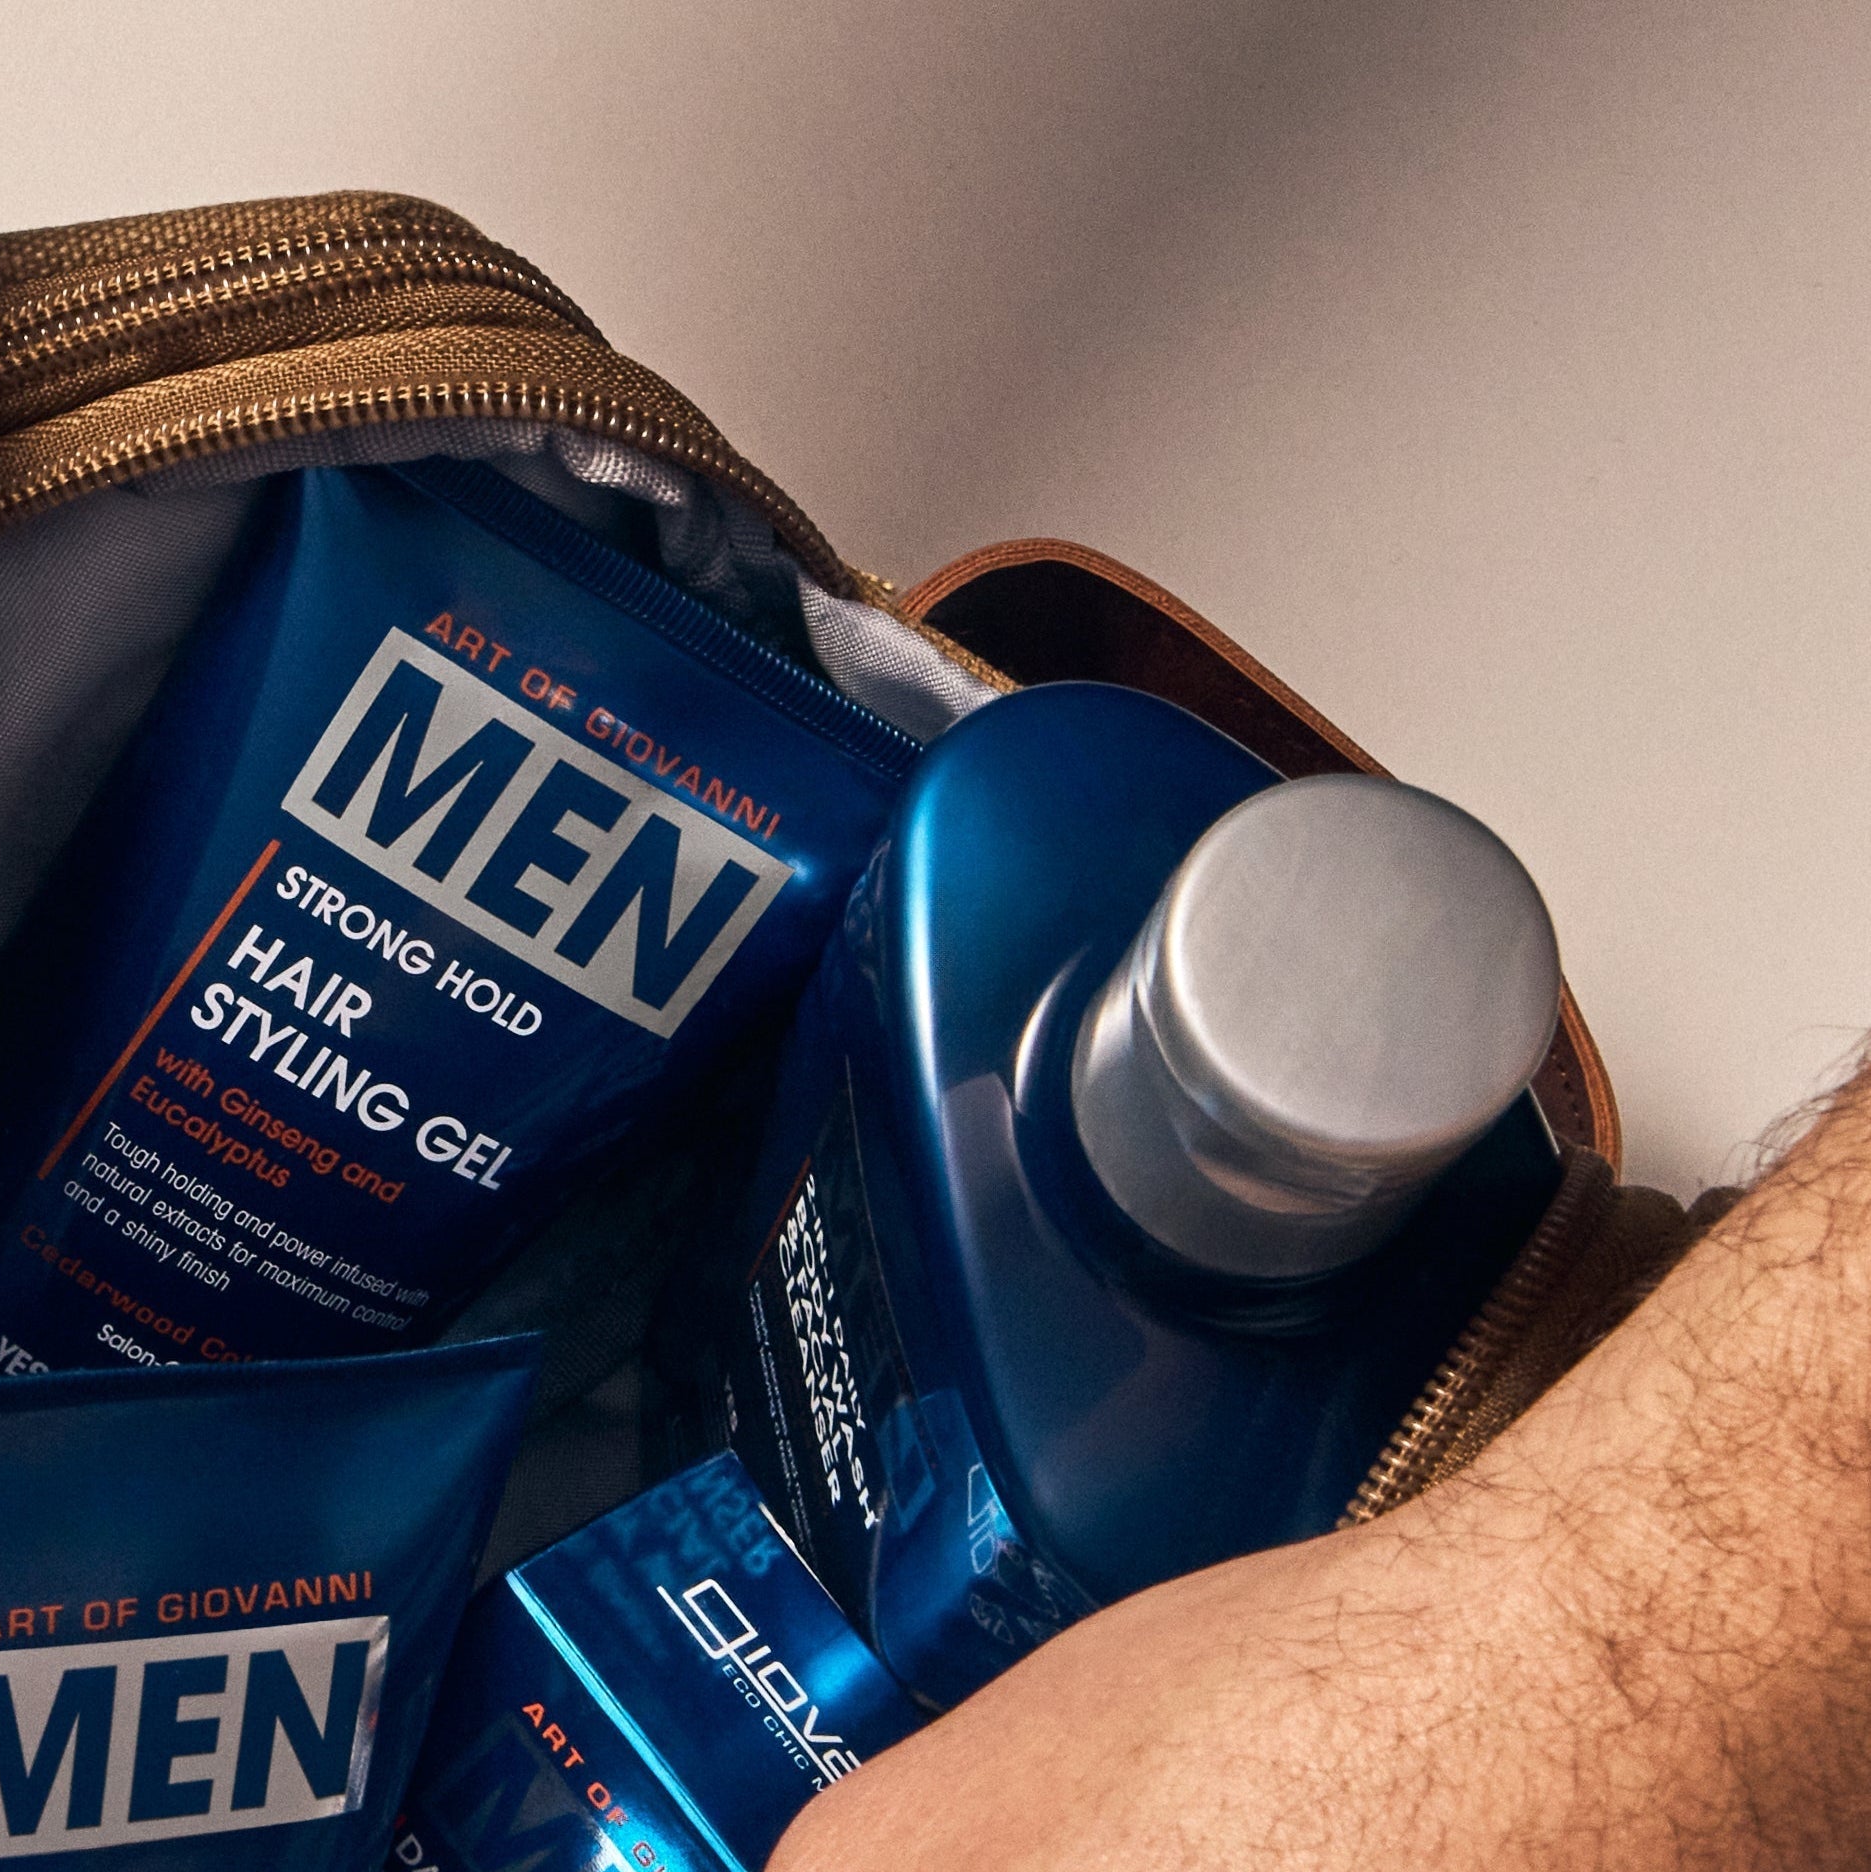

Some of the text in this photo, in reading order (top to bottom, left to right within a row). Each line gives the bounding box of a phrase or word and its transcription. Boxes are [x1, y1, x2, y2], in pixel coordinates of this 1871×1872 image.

[424, 612, 781, 840] ART OF GIOVANNI
[312, 660, 759, 1010] MEN
[227, 924, 373, 1038] HAIR
[276, 865, 543, 1036] STRONG HOLD
[129, 1074, 291, 1188] Eucalyptus
[155, 1047, 405, 1204] with Ginseng and
[190, 982, 513, 1190] STYLING GEL
[20, 1223, 196, 1345] Cedarwood
[63, 1180, 231, 1292] and a shiny finish
[81, 1153, 412, 1331] natural extracts for maximum control
[103, 1121, 161, 1174] Tough
[160, 1162, 234, 1221] holding
[233, 1209, 276, 1239] and
[268, 1230, 333, 1268] power
[330, 1256, 399, 1297] infused
[779, 1233, 841, 1508] CLEANSER
[795, 1194, 878, 1530] BODY WASH
[796, 1265, 841, 1463] FACIAL
[806, 1173, 867, 1431] 2-IN-1 DAILY
[82, 1597, 138, 1631] OF
[157, 1570, 372, 1623] GIOVANNI
[522, 1701, 585, 1769] ART
[586, 1781, 629, 1827] OF
[722, 1663, 809, 1770] ECO CHIC
